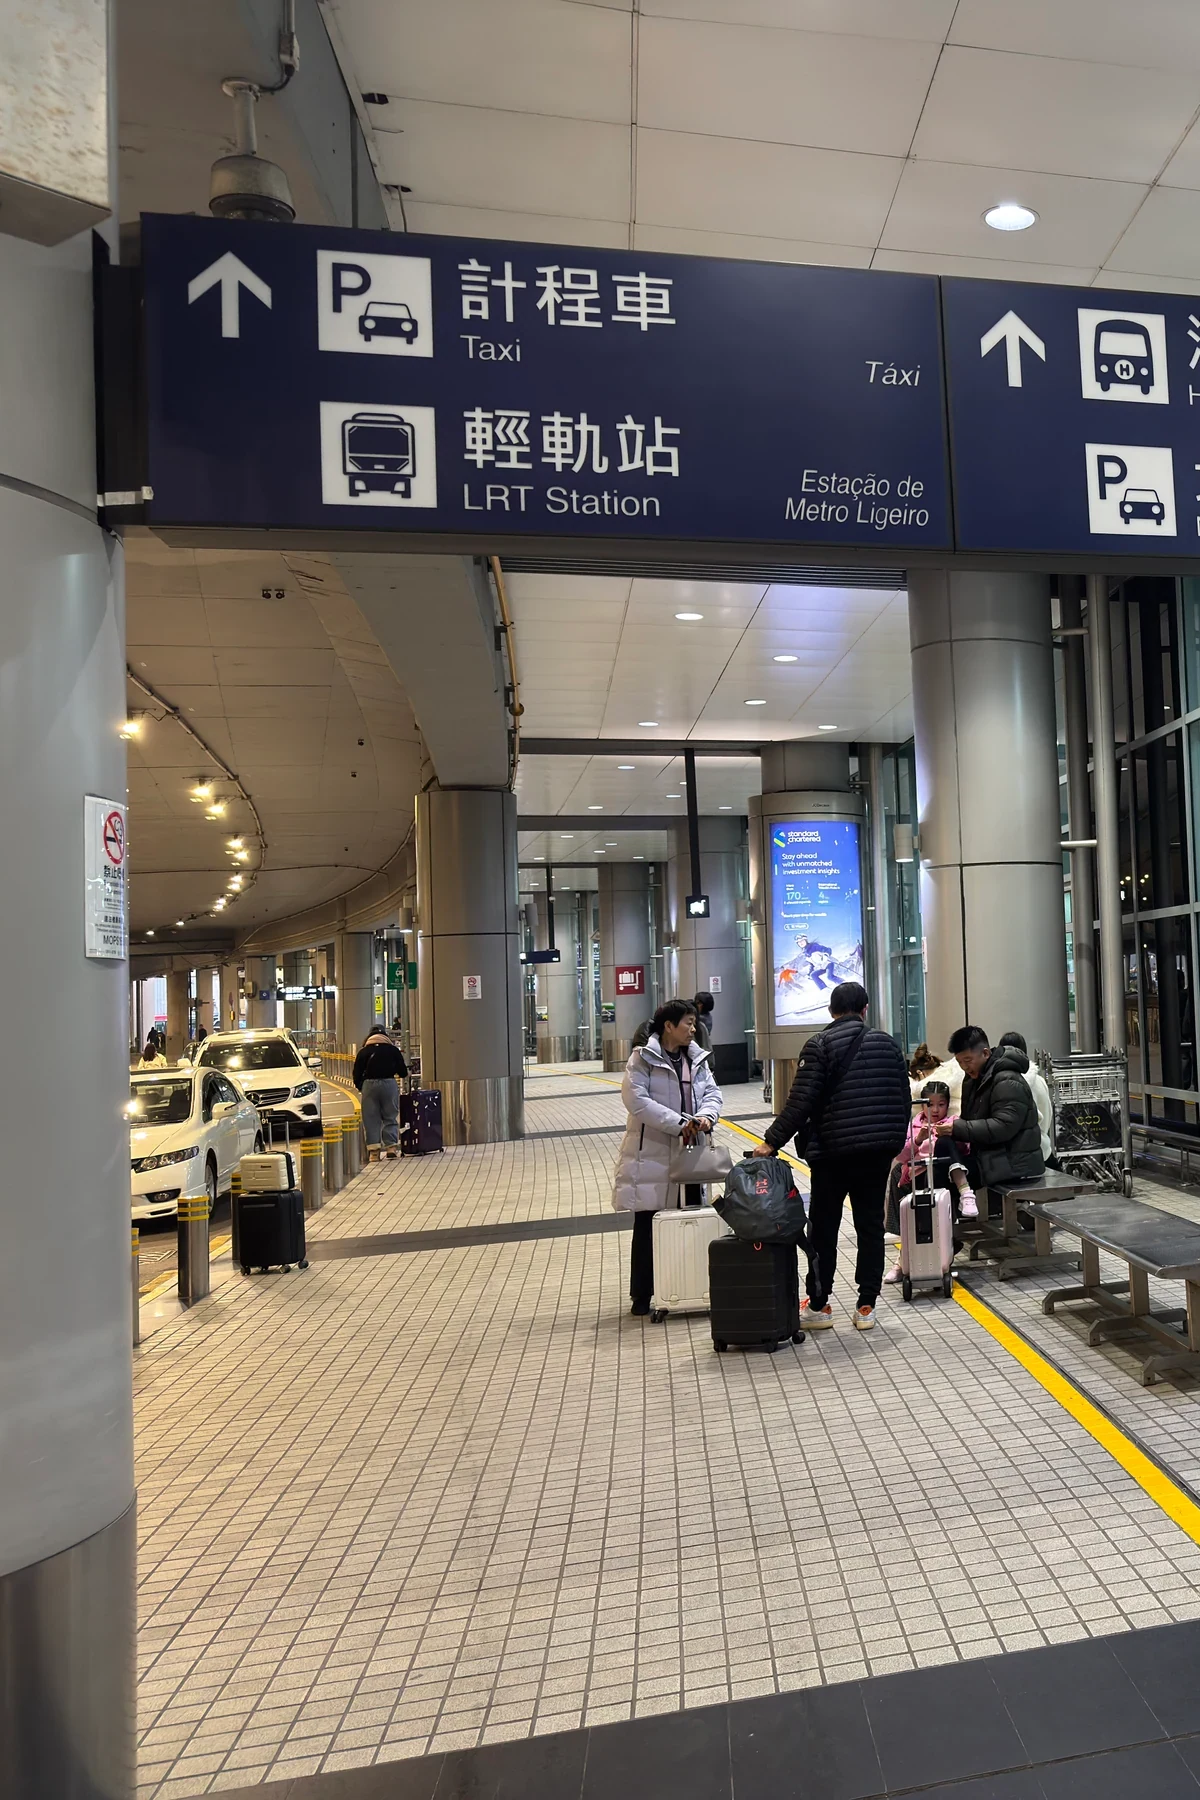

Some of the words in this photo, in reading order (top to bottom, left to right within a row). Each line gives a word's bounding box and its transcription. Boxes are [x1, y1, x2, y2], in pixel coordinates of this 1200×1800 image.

[458, 258, 676, 332] 計程車
[460, 335, 522, 362] Taxi
[866, 360, 921, 386] Táxi
[463, 406, 680, 477] 輕軌站
[463, 483, 534, 513] LRT
[547, 486, 660, 517] Station
[800, 469, 888, 501] Estação
[894, 475, 924, 498] de
[785, 497, 849, 523] Metro
[856, 500, 929, 530] Ligeiro
